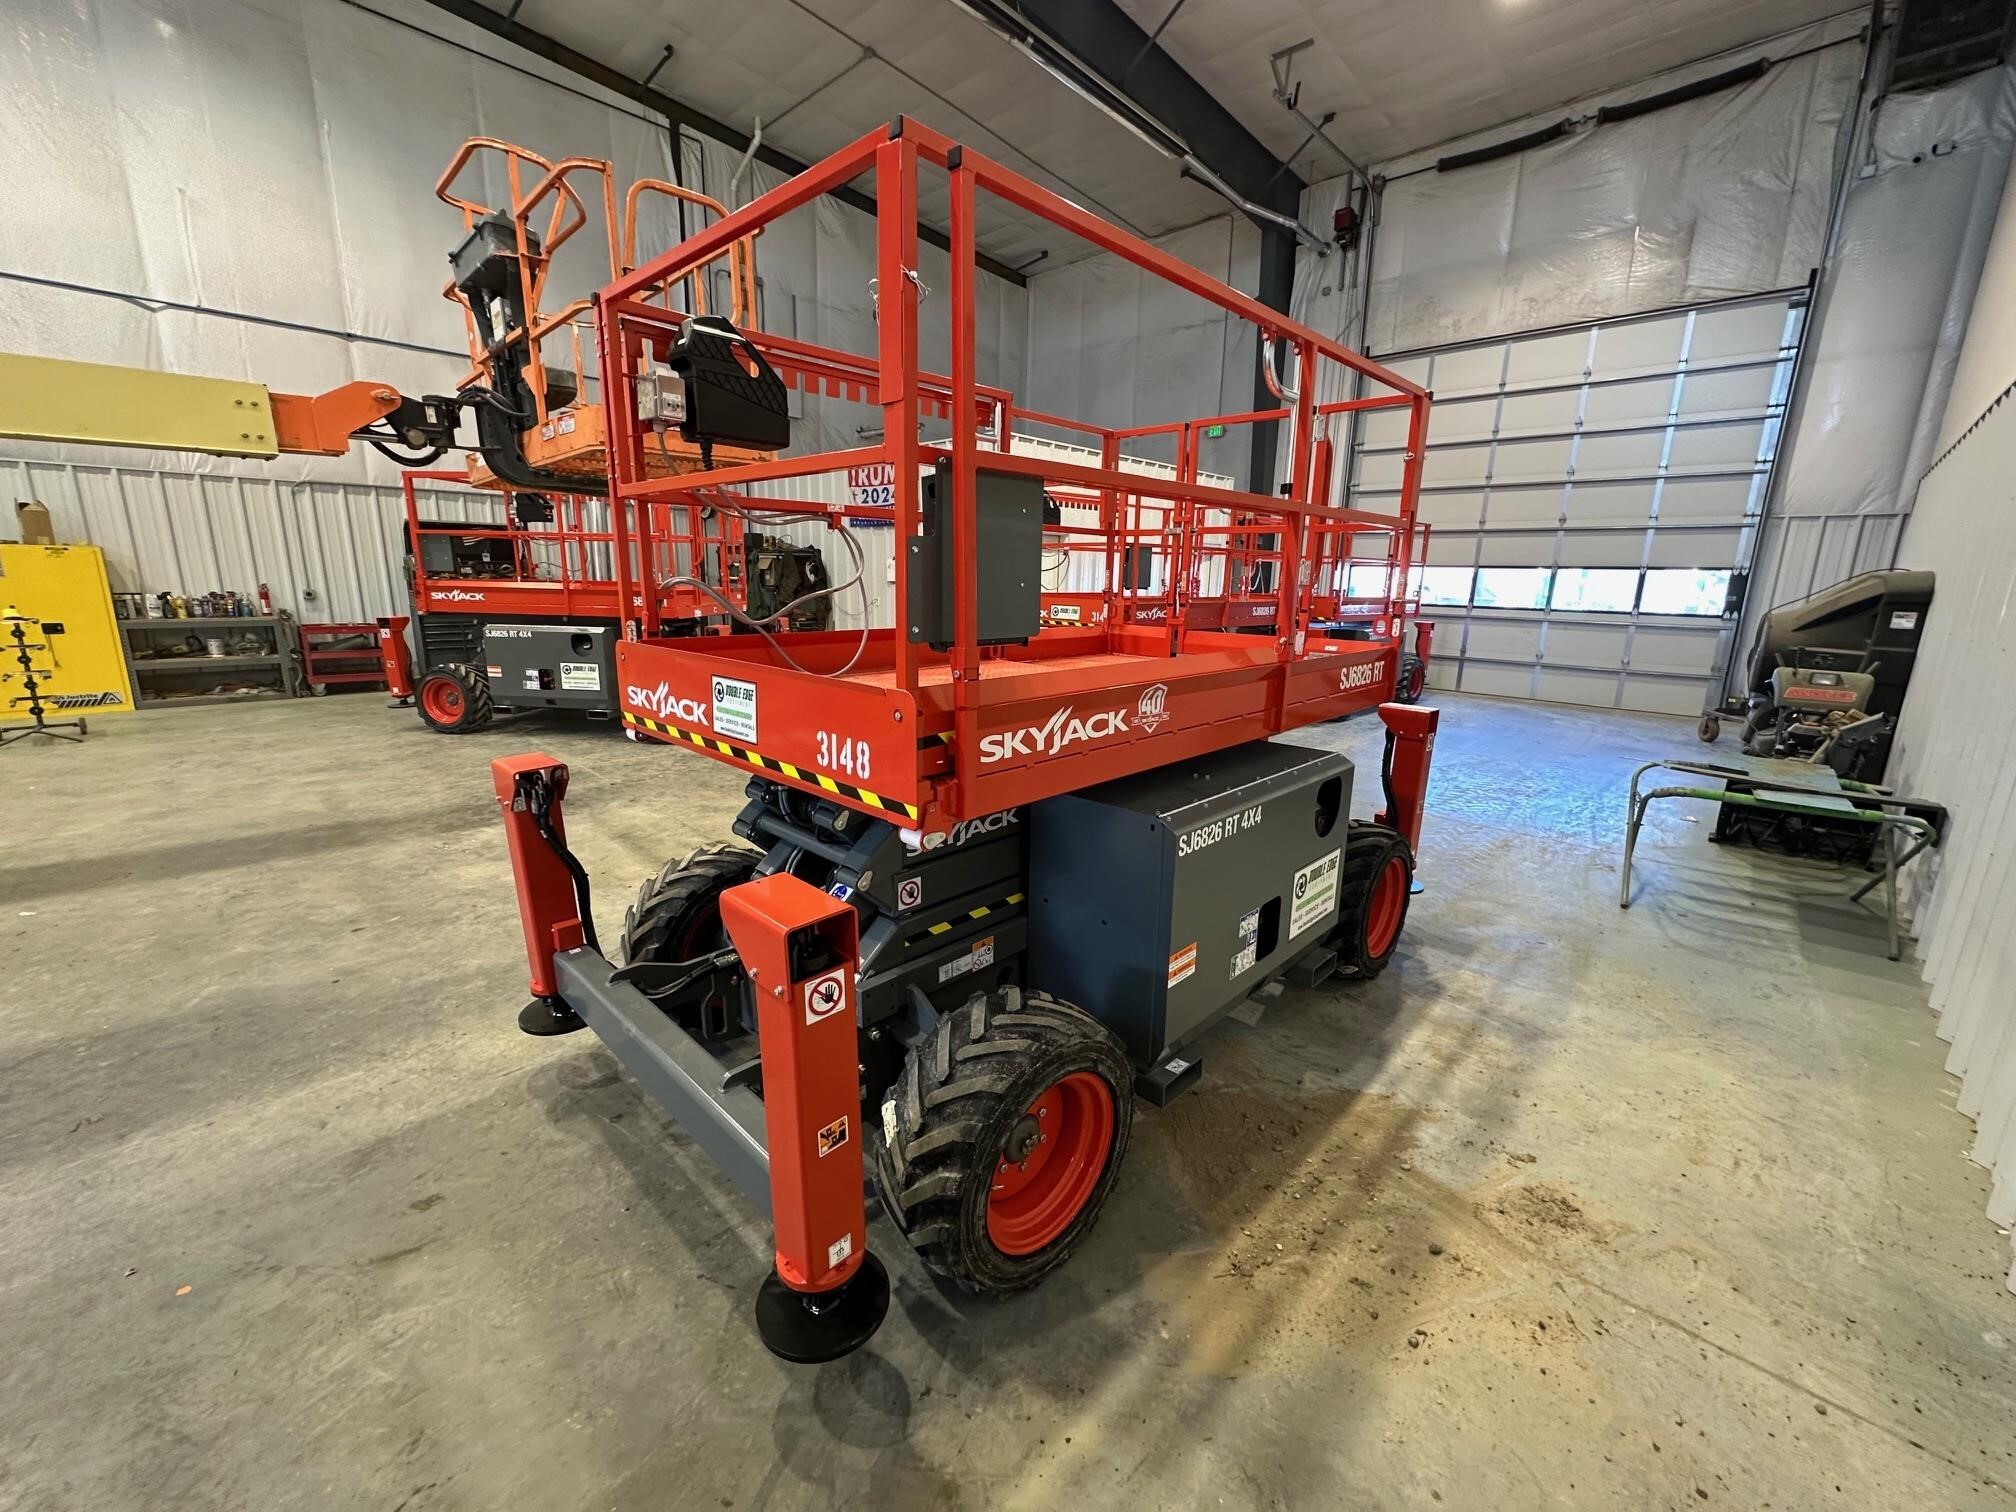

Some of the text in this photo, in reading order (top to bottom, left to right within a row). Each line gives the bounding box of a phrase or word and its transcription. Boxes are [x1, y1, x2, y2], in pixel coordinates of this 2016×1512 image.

[430, 589, 486, 601] SKYJACK
[1136, 607, 1167, 620] SKYJAC
[509, 630, 517, 638] RT
[518, 630, 532, 638] 4X4
[1340, 660, 1385, 690] SJ6826 RT
[627, 680, 710, 726] SKYJACK
[980, 705, 1129, 762] SKYJACK
[816, 730, 870, 780] 3148
[1178, 805, 1262, 857] SJ6826 RT 4X4
